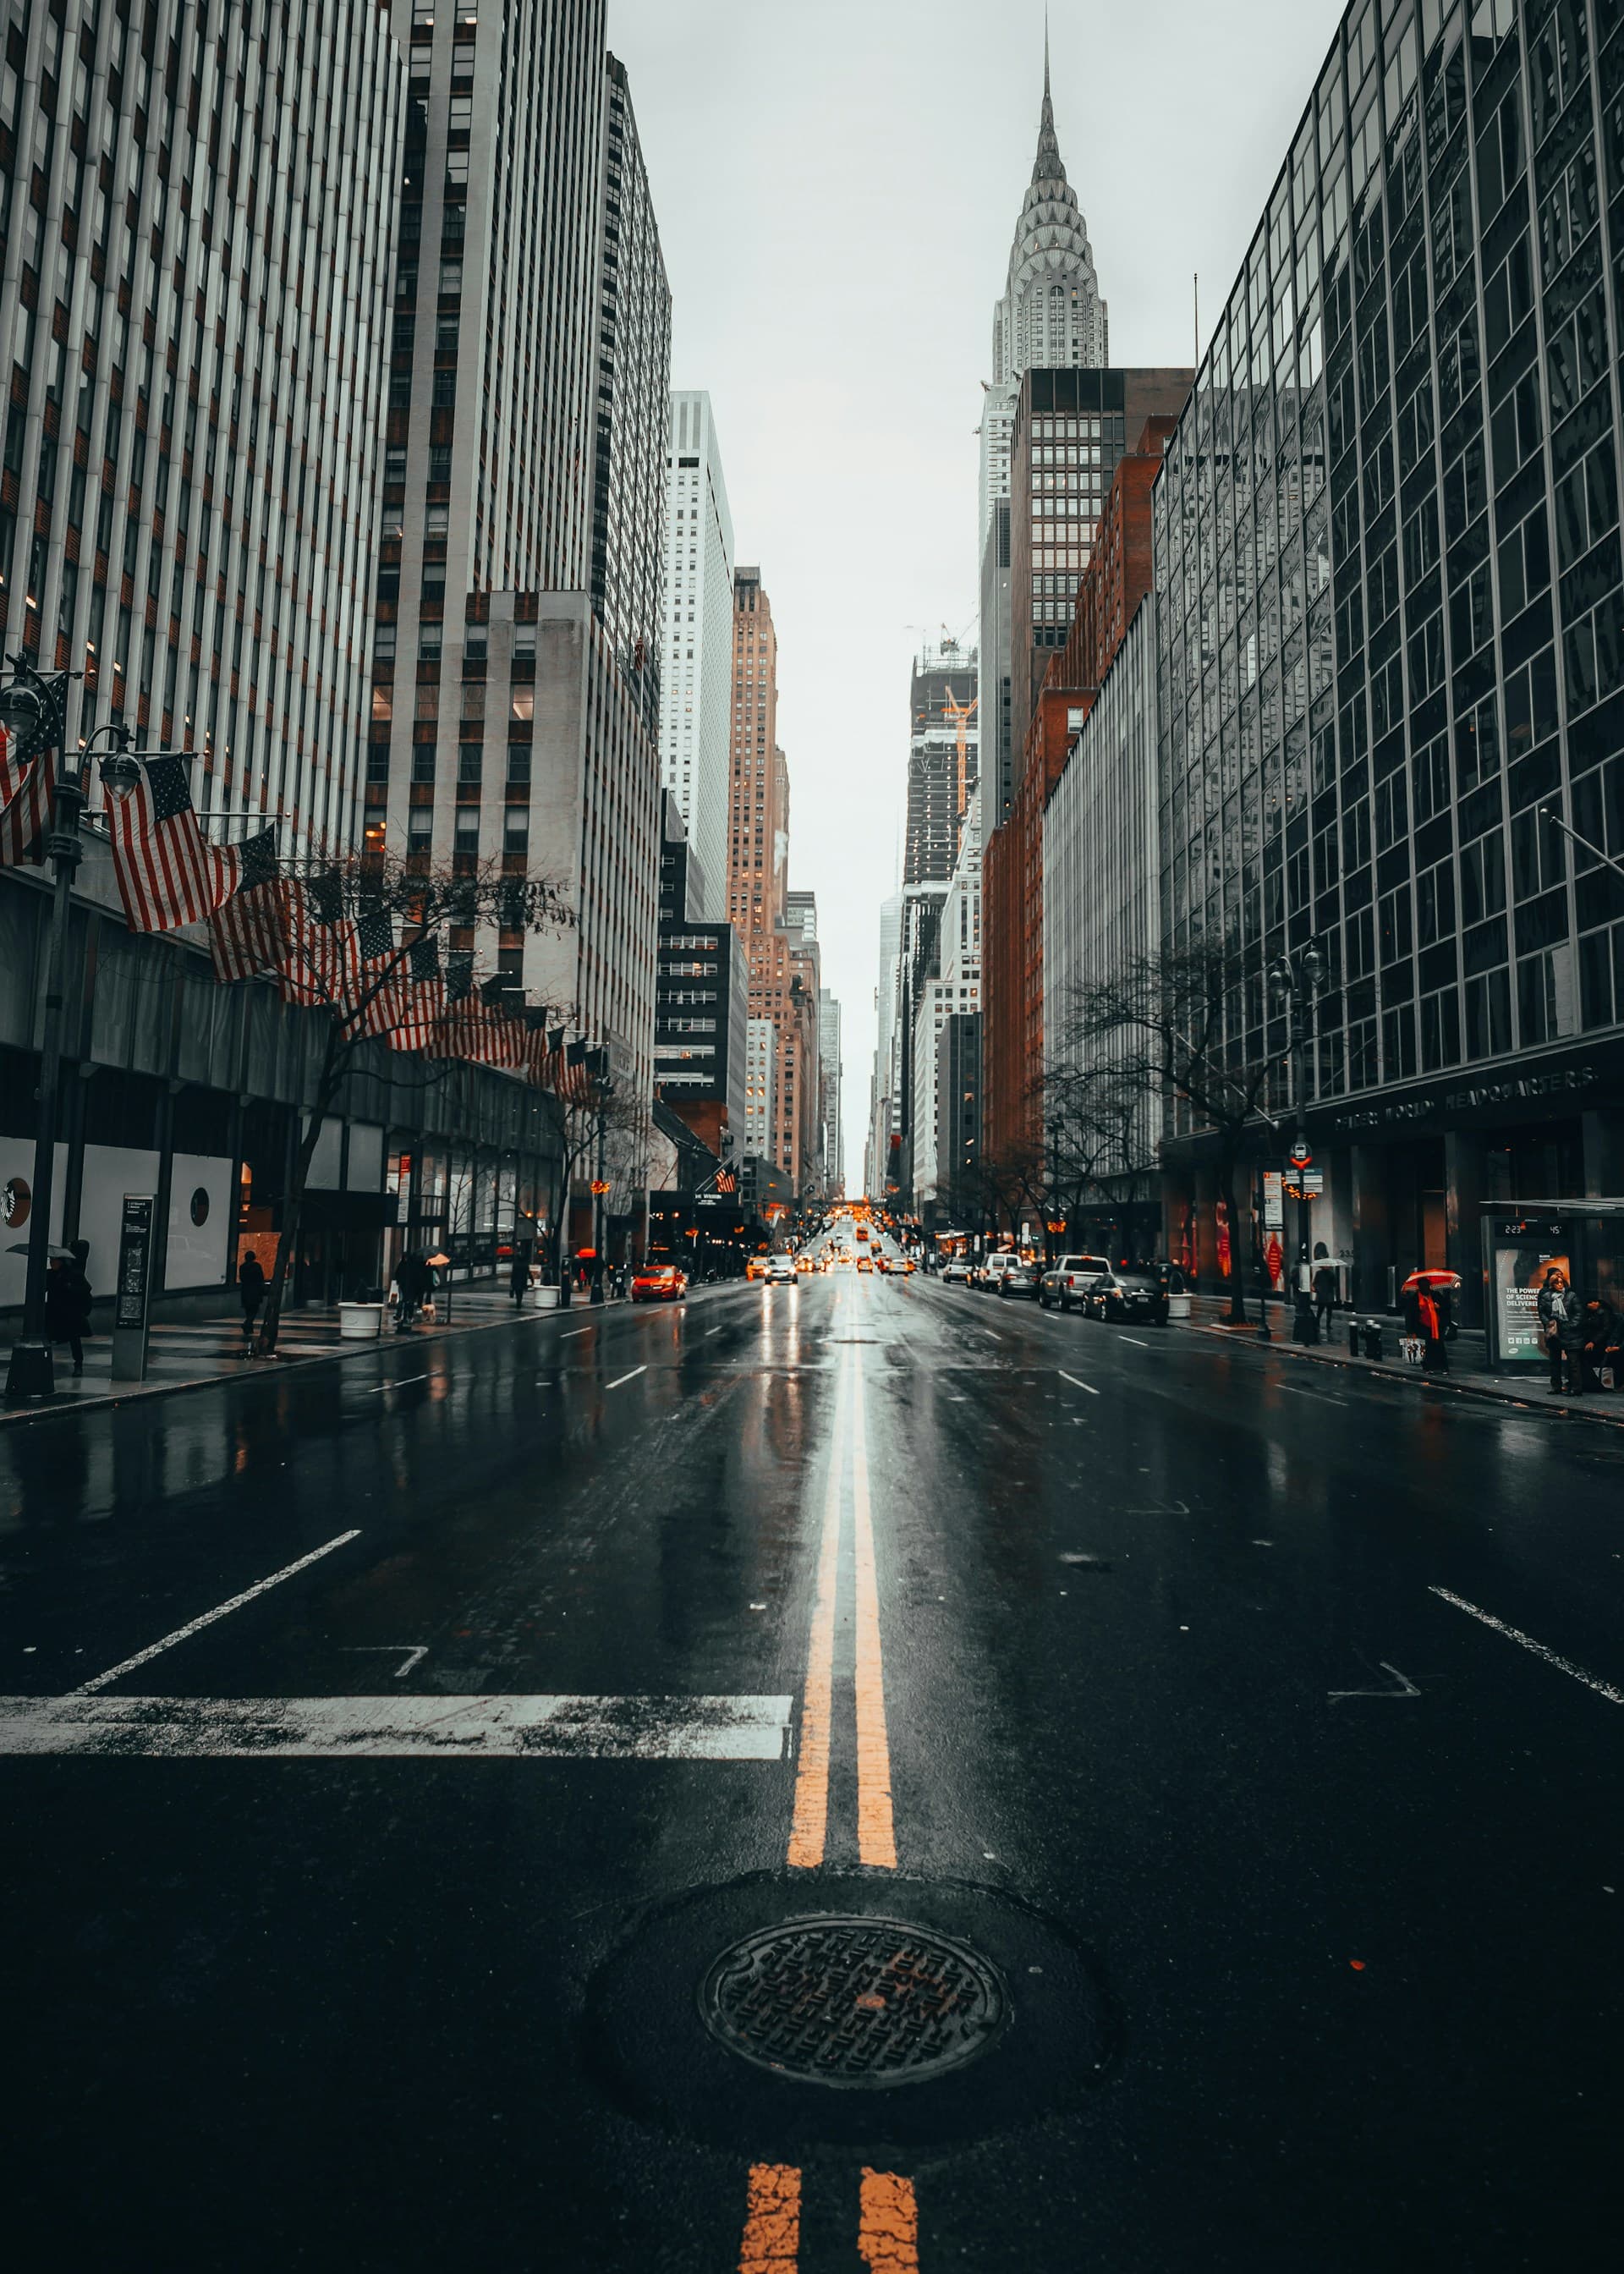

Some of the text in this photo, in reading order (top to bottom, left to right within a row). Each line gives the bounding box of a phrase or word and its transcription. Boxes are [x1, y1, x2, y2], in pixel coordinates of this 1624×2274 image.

[1385, 1100, 1435, 1118] WORLD
[1446, 1067, 1599, 1110] HEADQUARTERS
[1505, 1225, 1521, 1233] 2:23
